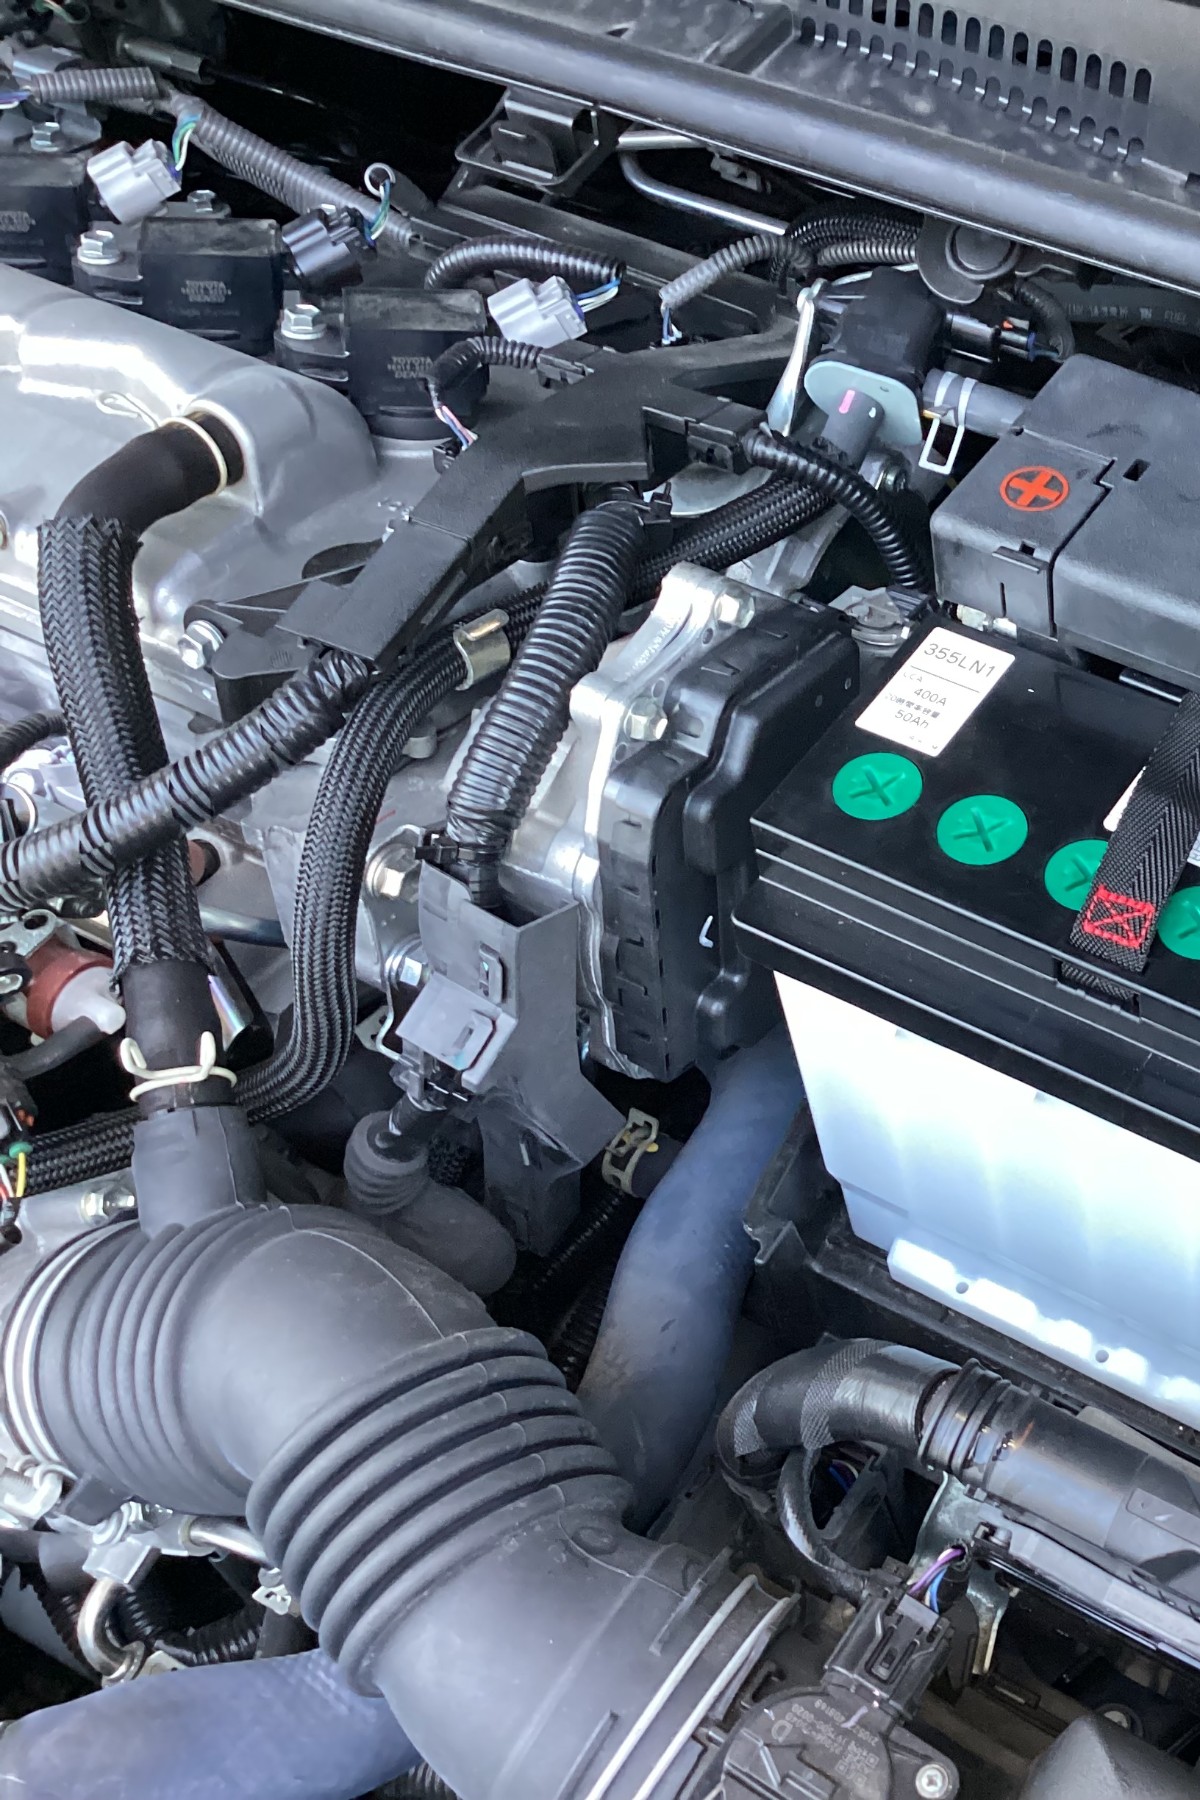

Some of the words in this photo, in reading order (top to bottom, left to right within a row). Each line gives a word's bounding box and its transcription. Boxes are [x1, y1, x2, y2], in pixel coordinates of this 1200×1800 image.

[924, 643, 995, 678] 355LN1
[913, 686, 947, 706] 400A
[894, 708, 929, 729] 50Ah
